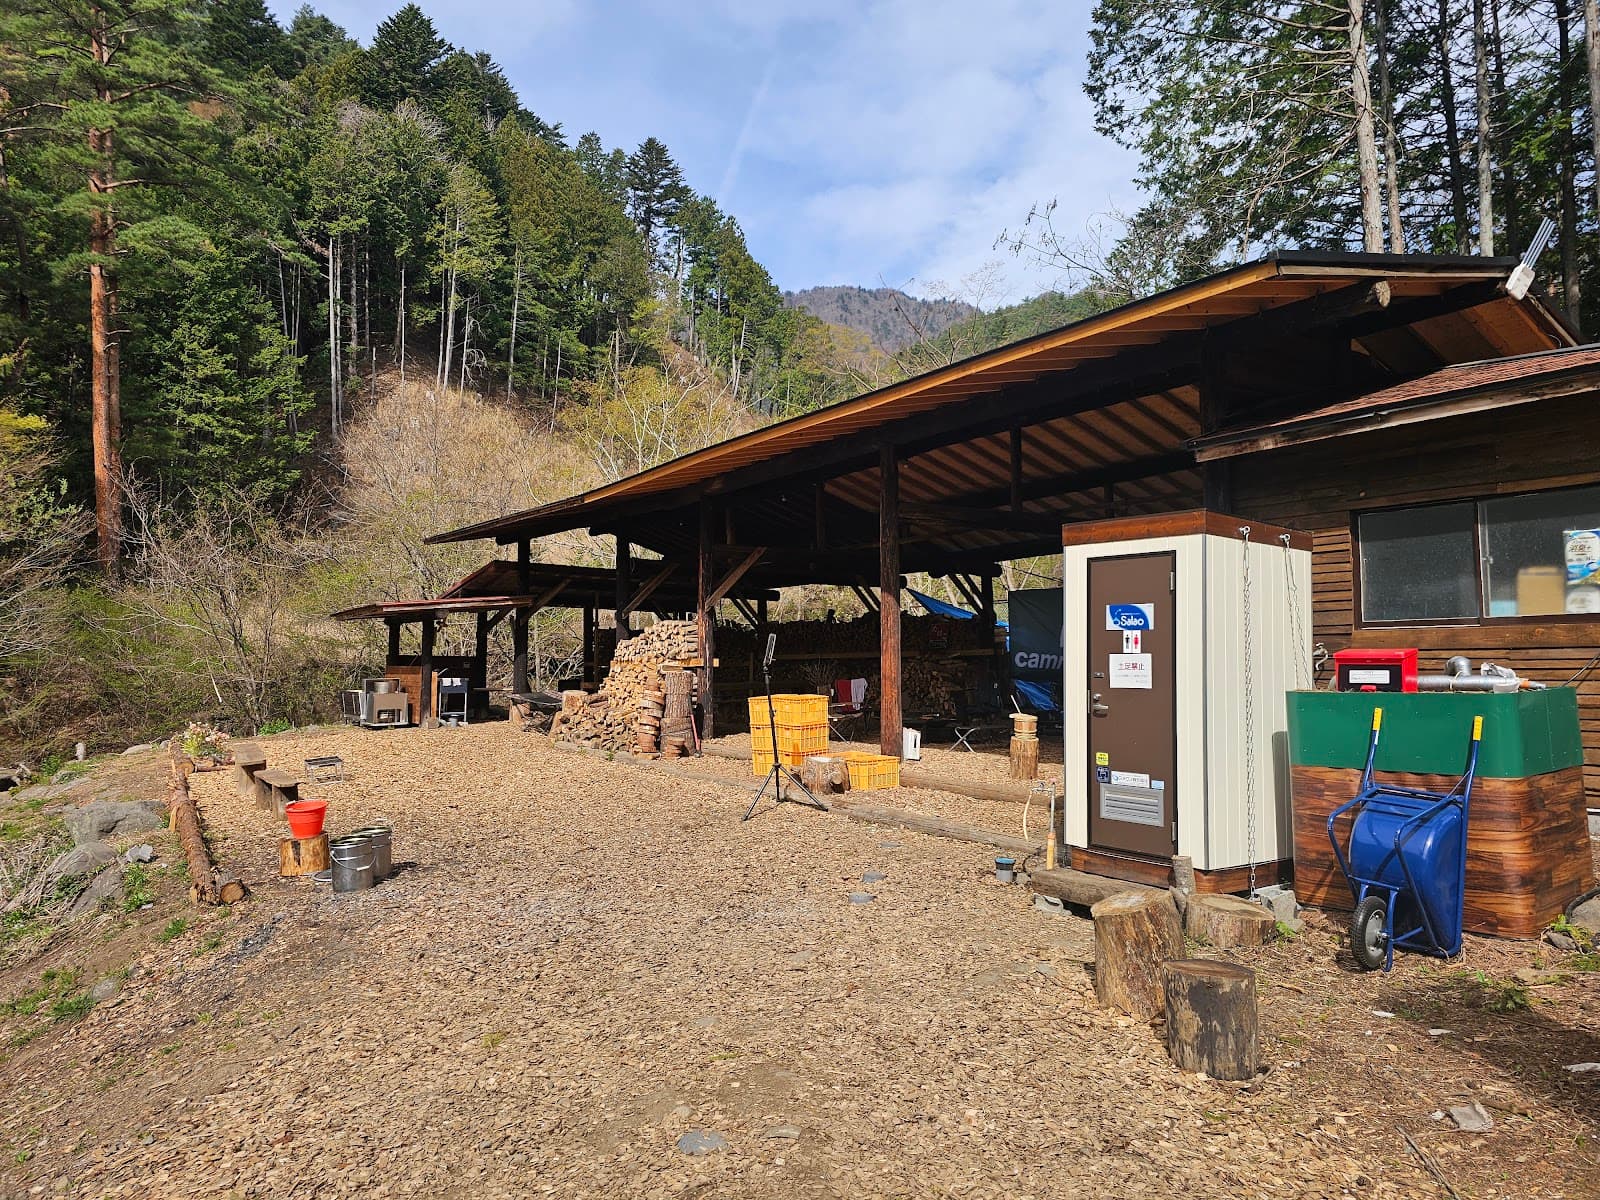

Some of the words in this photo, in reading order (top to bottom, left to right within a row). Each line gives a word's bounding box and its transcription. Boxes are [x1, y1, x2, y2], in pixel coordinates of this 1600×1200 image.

[1121, 615, 1144, 626] Salao
[1117, 662, 1145, 671] 土足禁止
